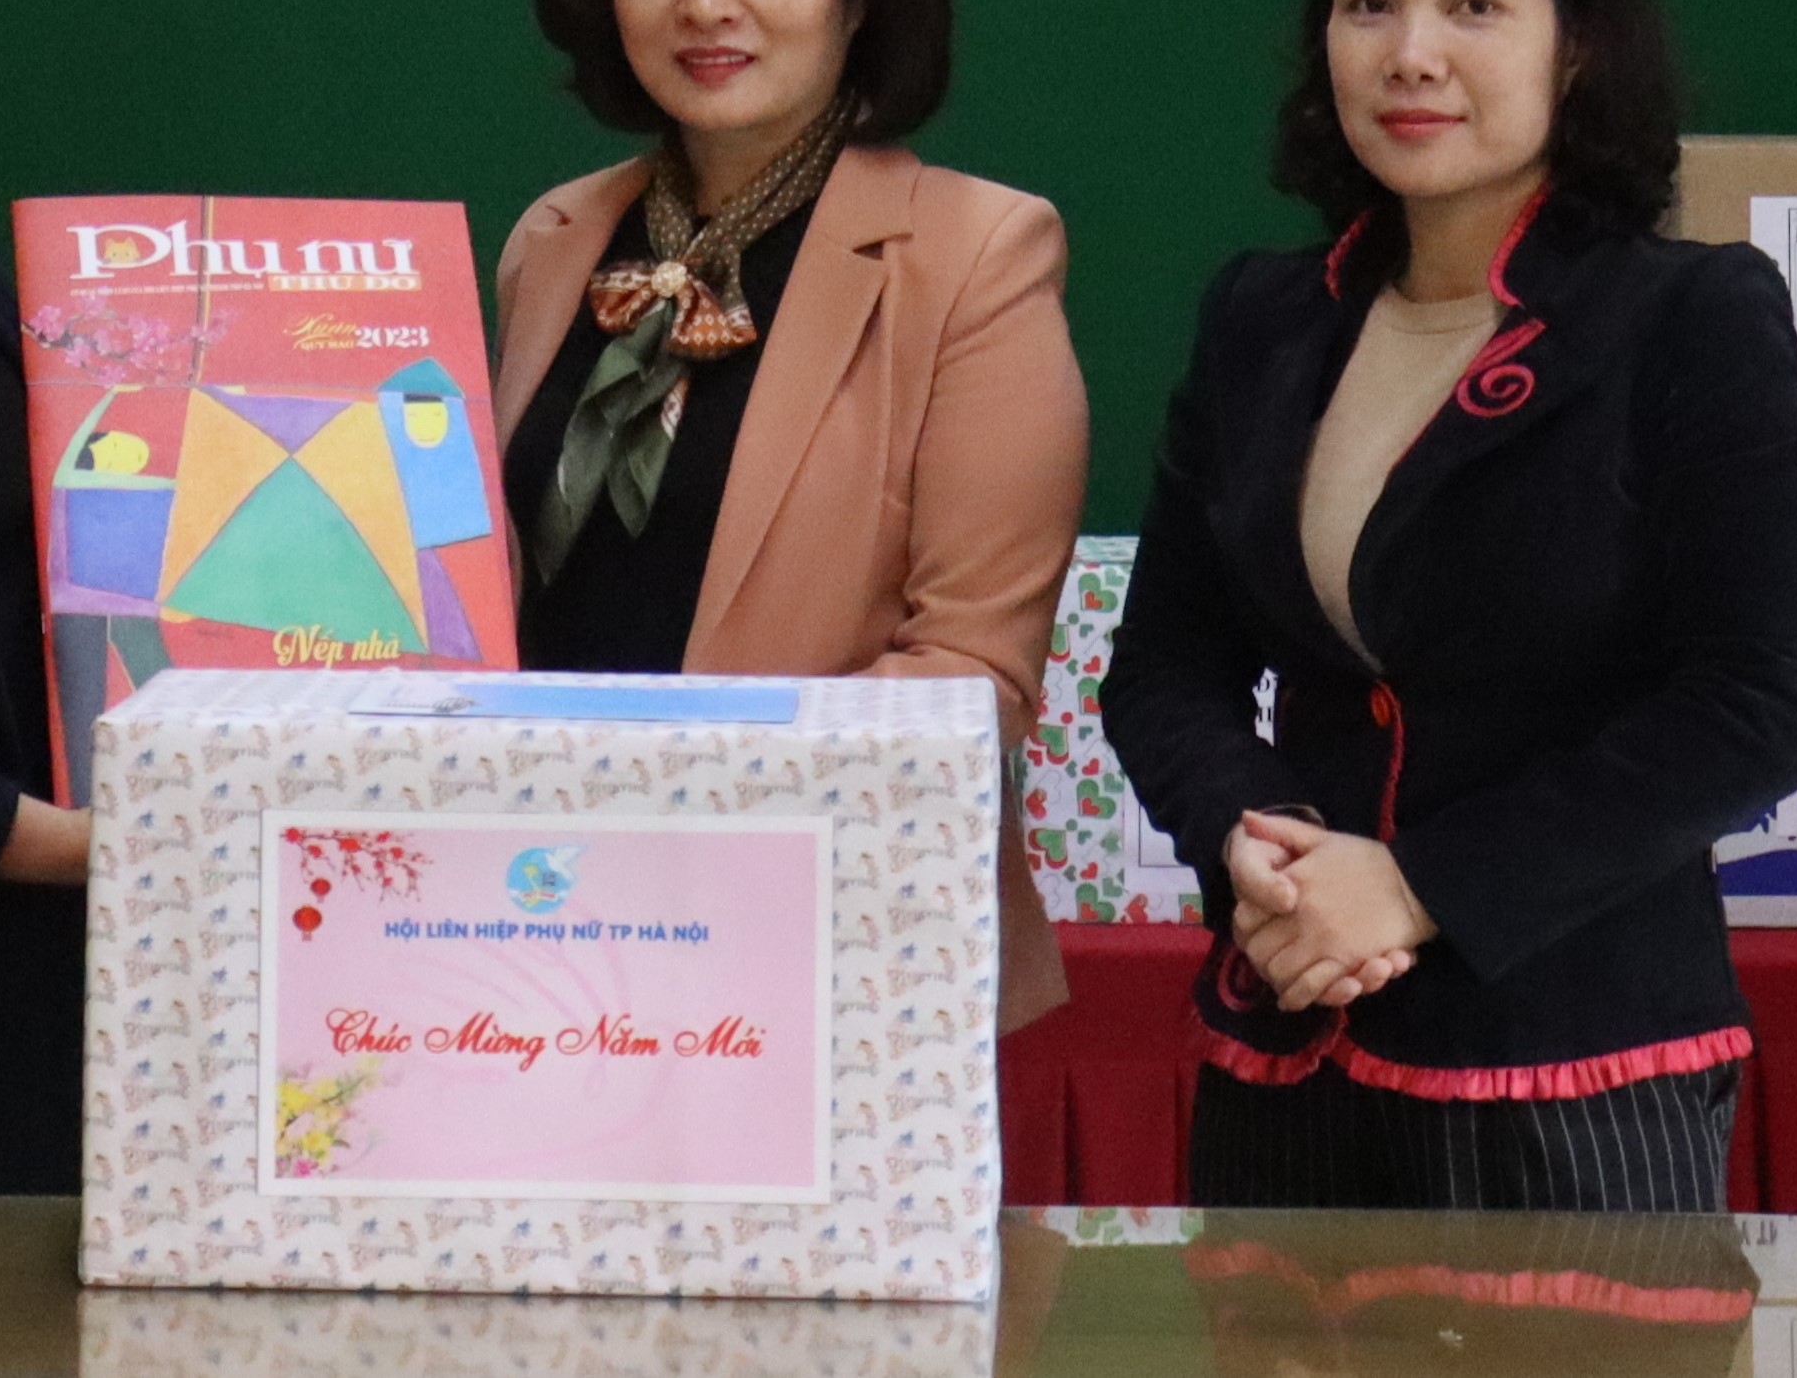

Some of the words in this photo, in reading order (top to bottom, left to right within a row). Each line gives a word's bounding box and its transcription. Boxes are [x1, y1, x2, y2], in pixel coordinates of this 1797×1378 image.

[66, 219, 290, 280] Phụ
[354, 325, 431, 349] 2023
[384, 918, 420, 942] HỘI
[426, 919, 469, 939] LIÊN
[475, 918, 519, 942] HIỆP
[525, 923, 566, 944] PHỤ
[572, 920, 604, 940] NỮ
[609, 924, 633, 940] TP
[638, 919, 667, 941] HÀ
[672, 921, 709, 945] NỘI
[325, 1008, 413, 1057] Chúc
[423, 1012, 547, 1073] Mừng
[555, 1013, 662, 1058] Năm
[673, 1015, 767, 1059] Mới
